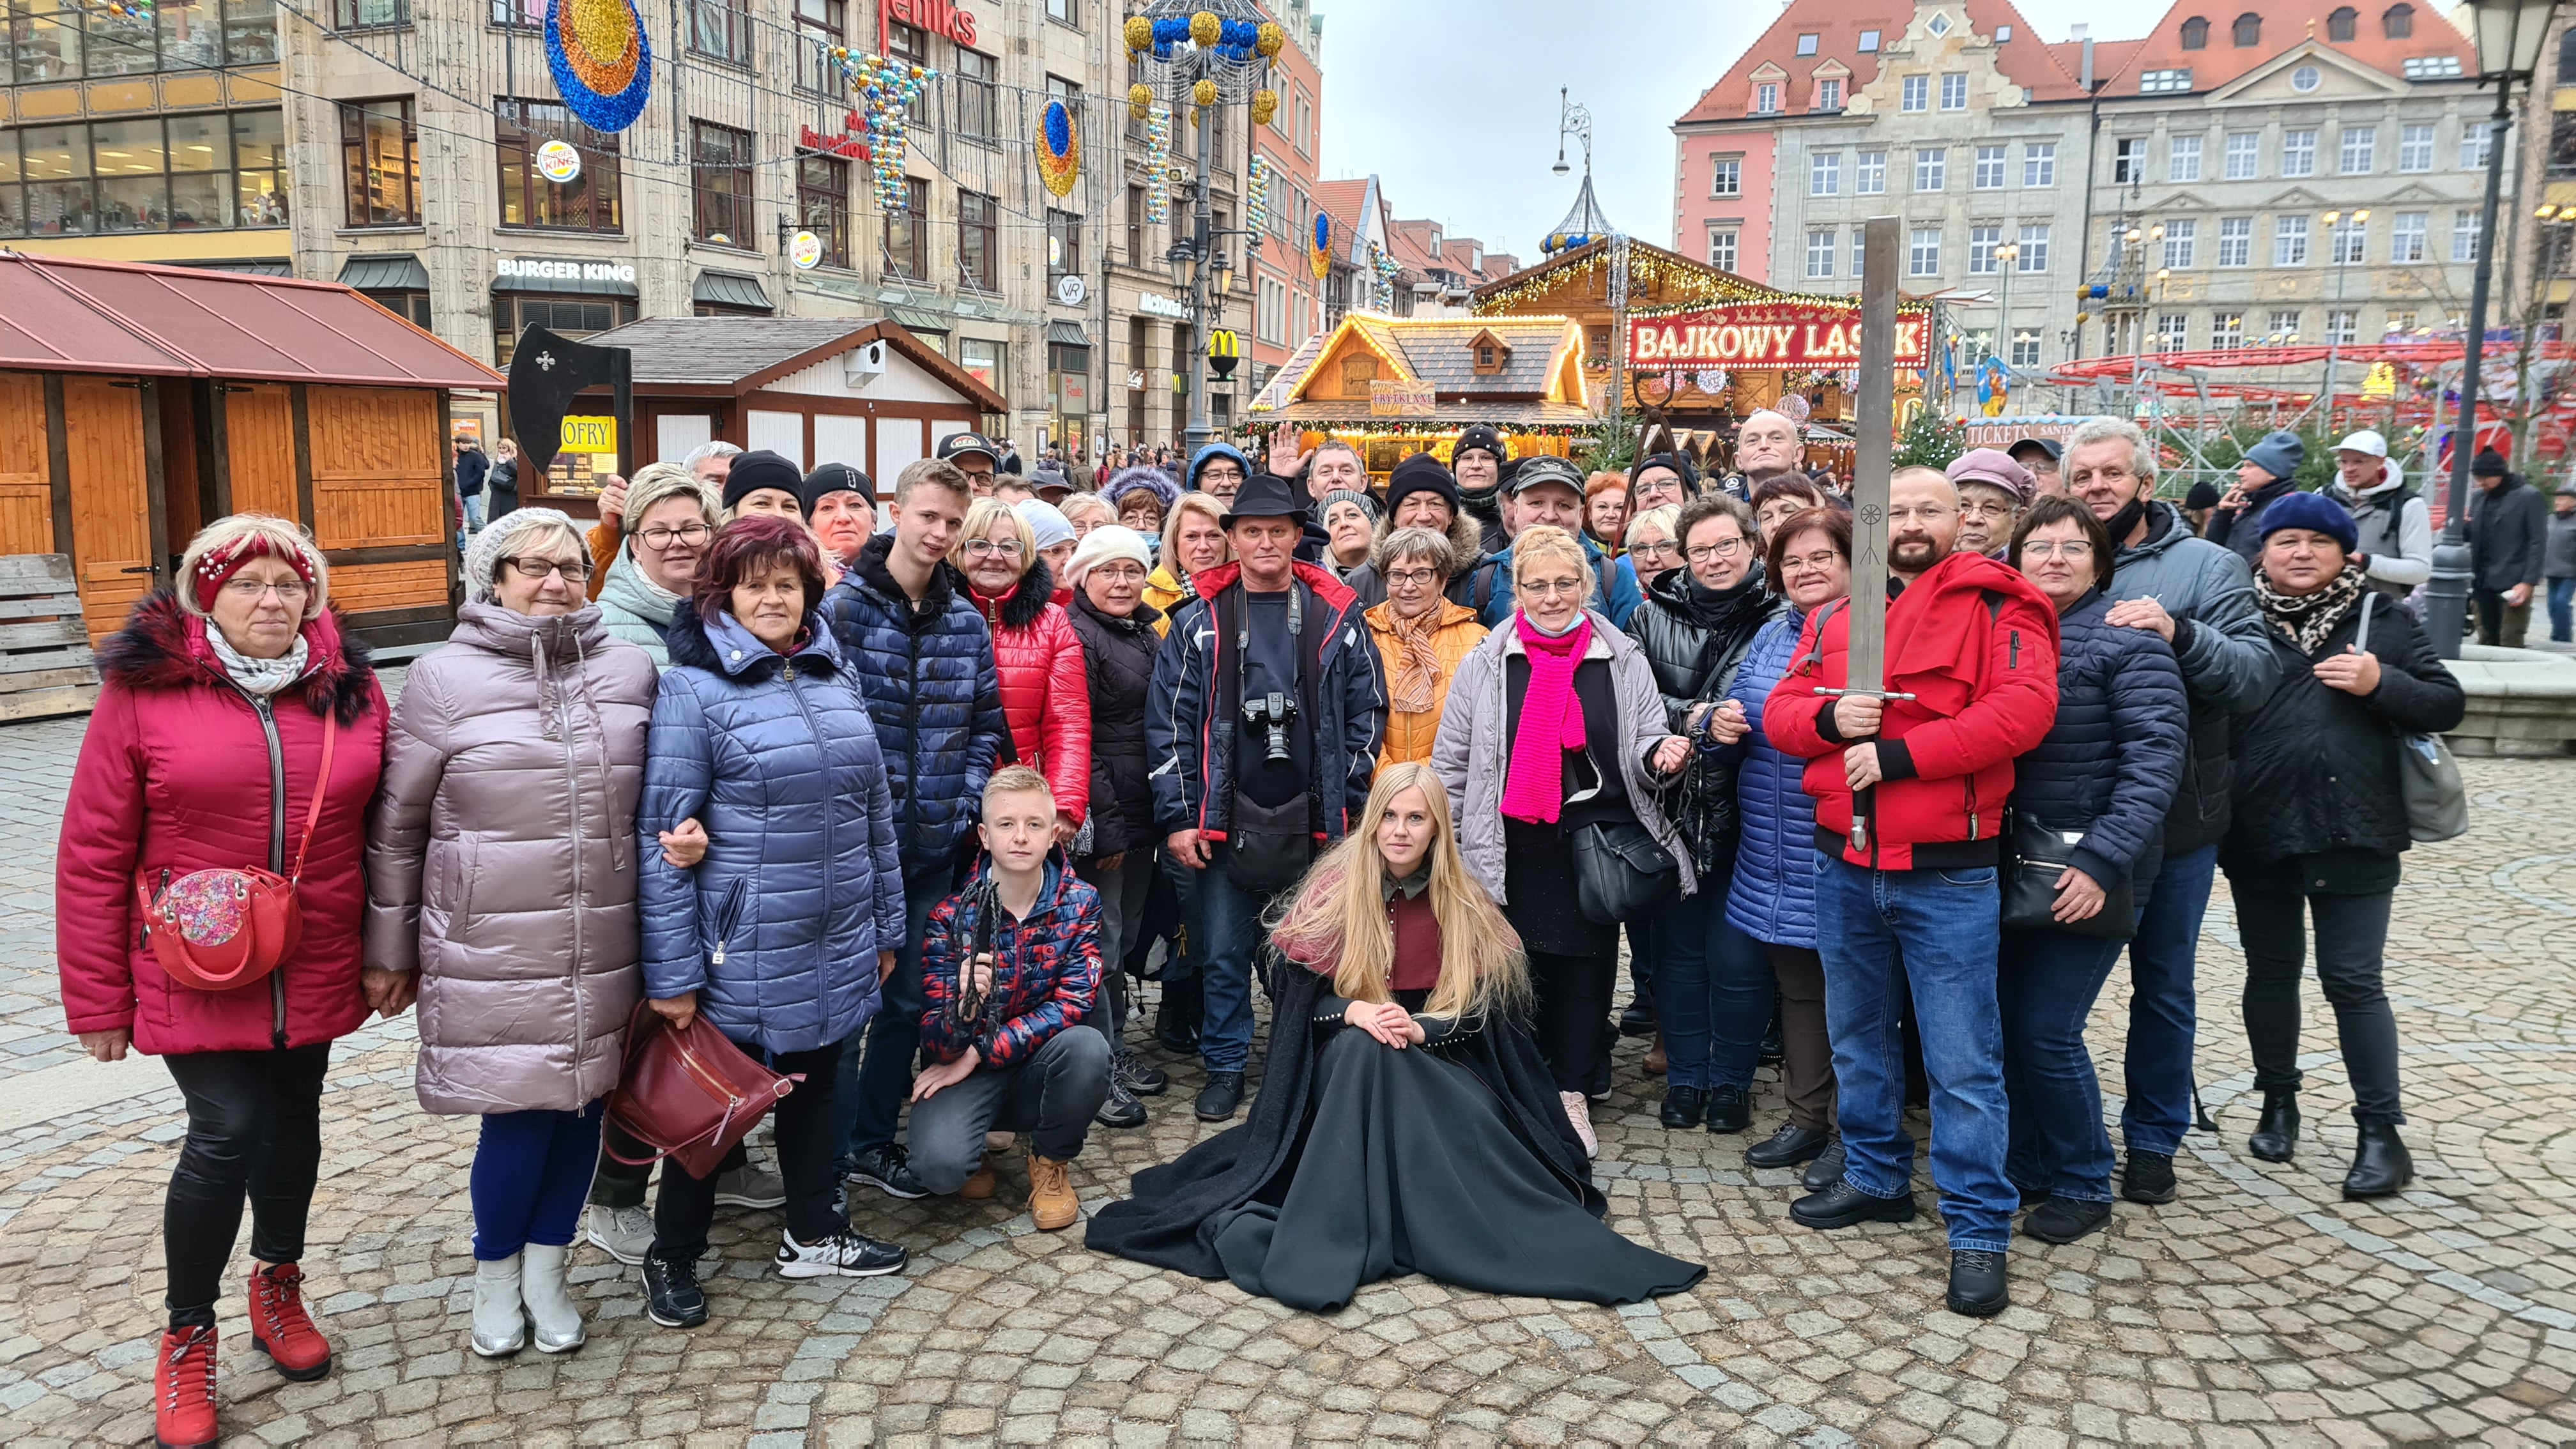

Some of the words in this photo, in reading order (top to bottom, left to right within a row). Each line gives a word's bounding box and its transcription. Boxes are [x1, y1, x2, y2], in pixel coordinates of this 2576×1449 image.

[542, 150, 572, 162] BURGER
[545, 156, 574, 171] KING
[794, 238, 816, 251] BURGER
[795, 245, 816, 259] KING
[497, 259, 581, 279] BURGER
[583, 263, 635, 282] KING
[1062, 283, 1080, 297] VR
[1139, 291, 1194, 319] McDona
[1636, 324, 1797, 358] BAJKOWY
[1804, 323, 1921, 356] LASK
[1374, 393, 1409, 403] FRYTKI
[1413, 393, 1434, 403] XXL
[563, 422, 608, 445] OFRY
[1969, 424, 2030, 445] TICKETS
[2041, 425, 2074, 436] SANTA
